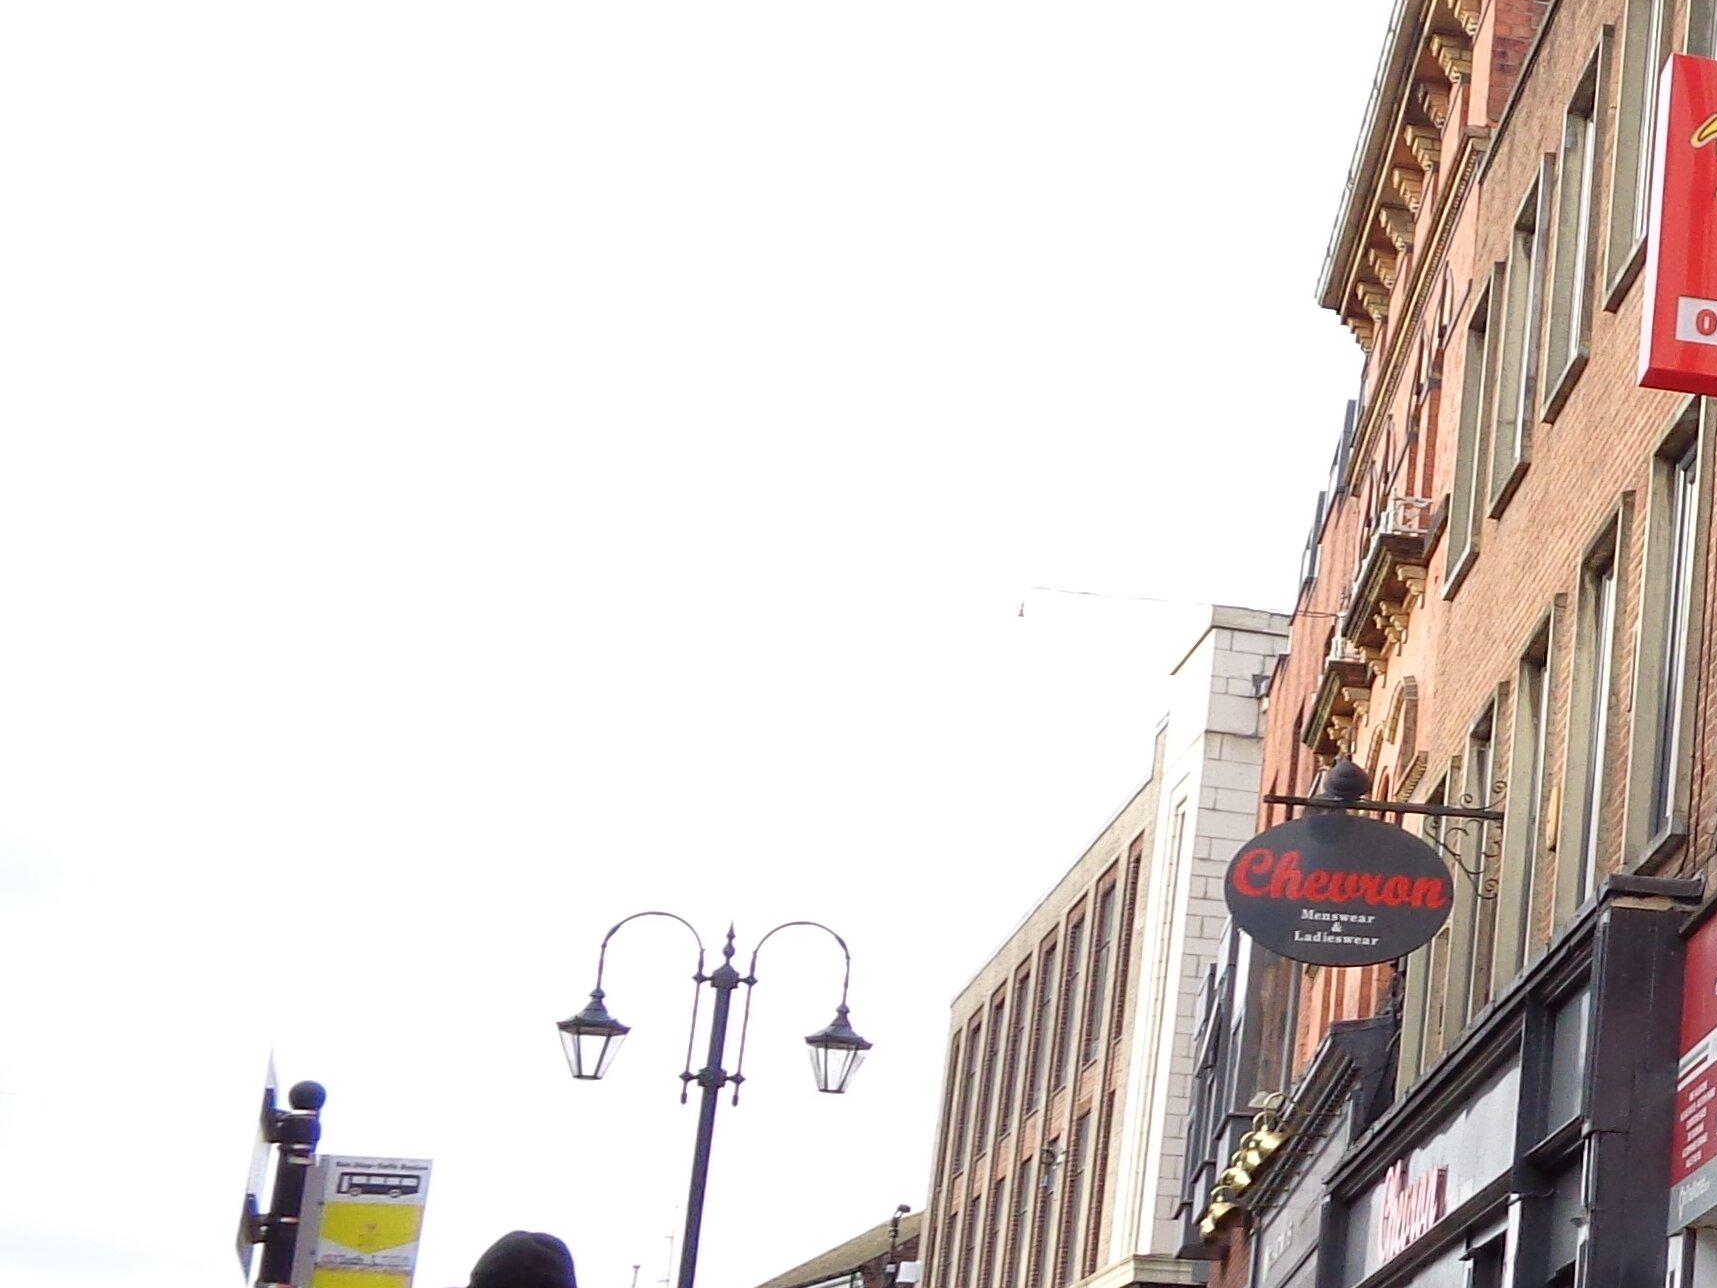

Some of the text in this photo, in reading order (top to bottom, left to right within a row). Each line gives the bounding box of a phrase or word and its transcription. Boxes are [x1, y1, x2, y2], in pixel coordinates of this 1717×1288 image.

[1233, 848, 1446, 908] Chevron
[1301, 908, 1376, 924] Menswear
[1331, 921, 1342, 933] &
[1294, 930, 1380, 947] Ladieswear
